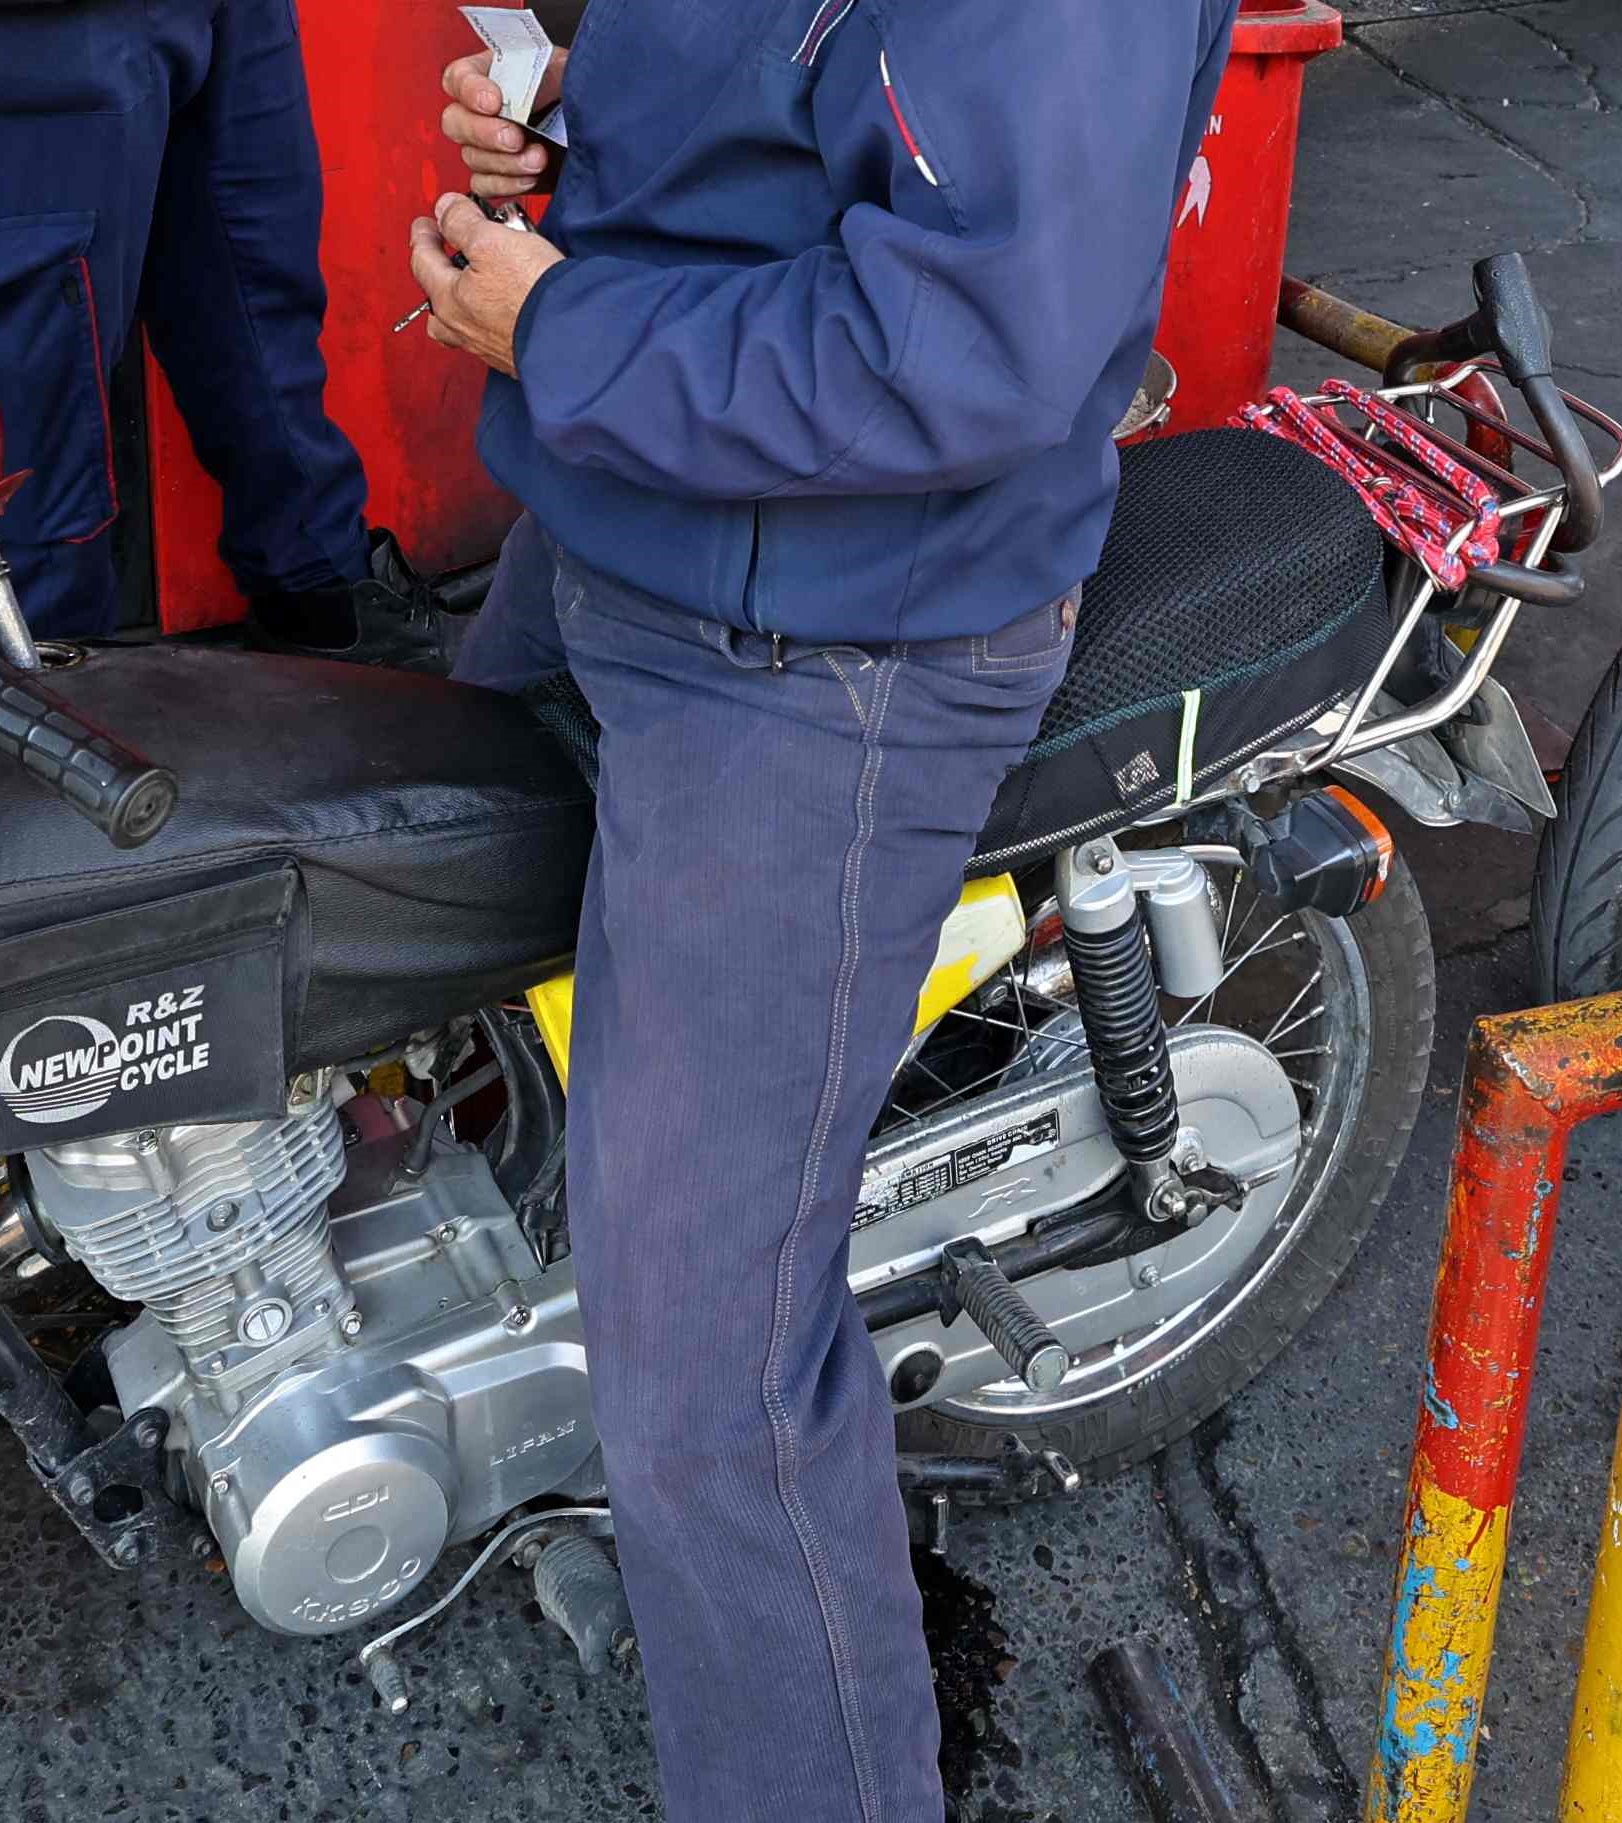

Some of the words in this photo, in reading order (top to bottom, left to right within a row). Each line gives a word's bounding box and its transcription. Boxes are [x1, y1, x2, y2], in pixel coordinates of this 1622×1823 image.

[126, 984, 206, 1027] R&Z
[120, 1042, 211, 1092] CYCLE
[490, 1419, 577, 1467] LIFAN
[321, 1485, 390, 1523] CDI
